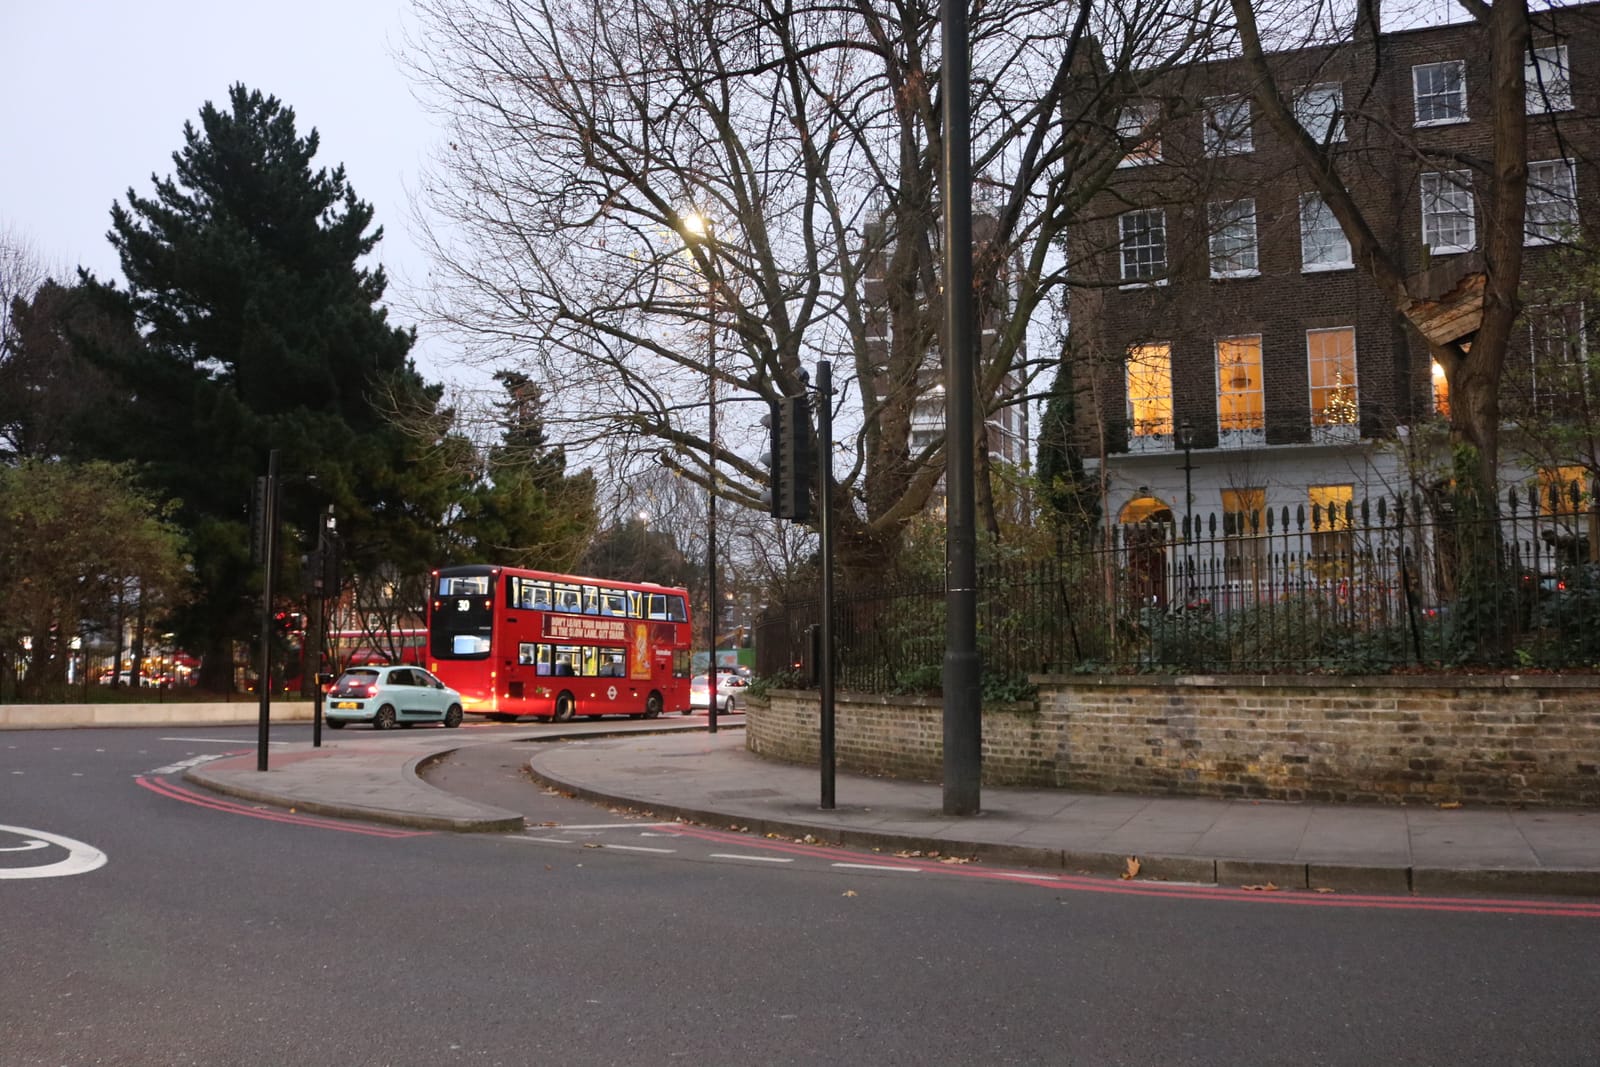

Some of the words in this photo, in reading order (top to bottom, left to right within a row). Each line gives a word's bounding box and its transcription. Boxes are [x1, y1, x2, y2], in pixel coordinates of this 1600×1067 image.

[457, 599, 470, 611] 30
[552, 617, 566, 626] DON'T
[567, 618, 581, 628] LEAVE
[559, 627, 568, 636] THE
[569, 628, 583, 637] SLOW
